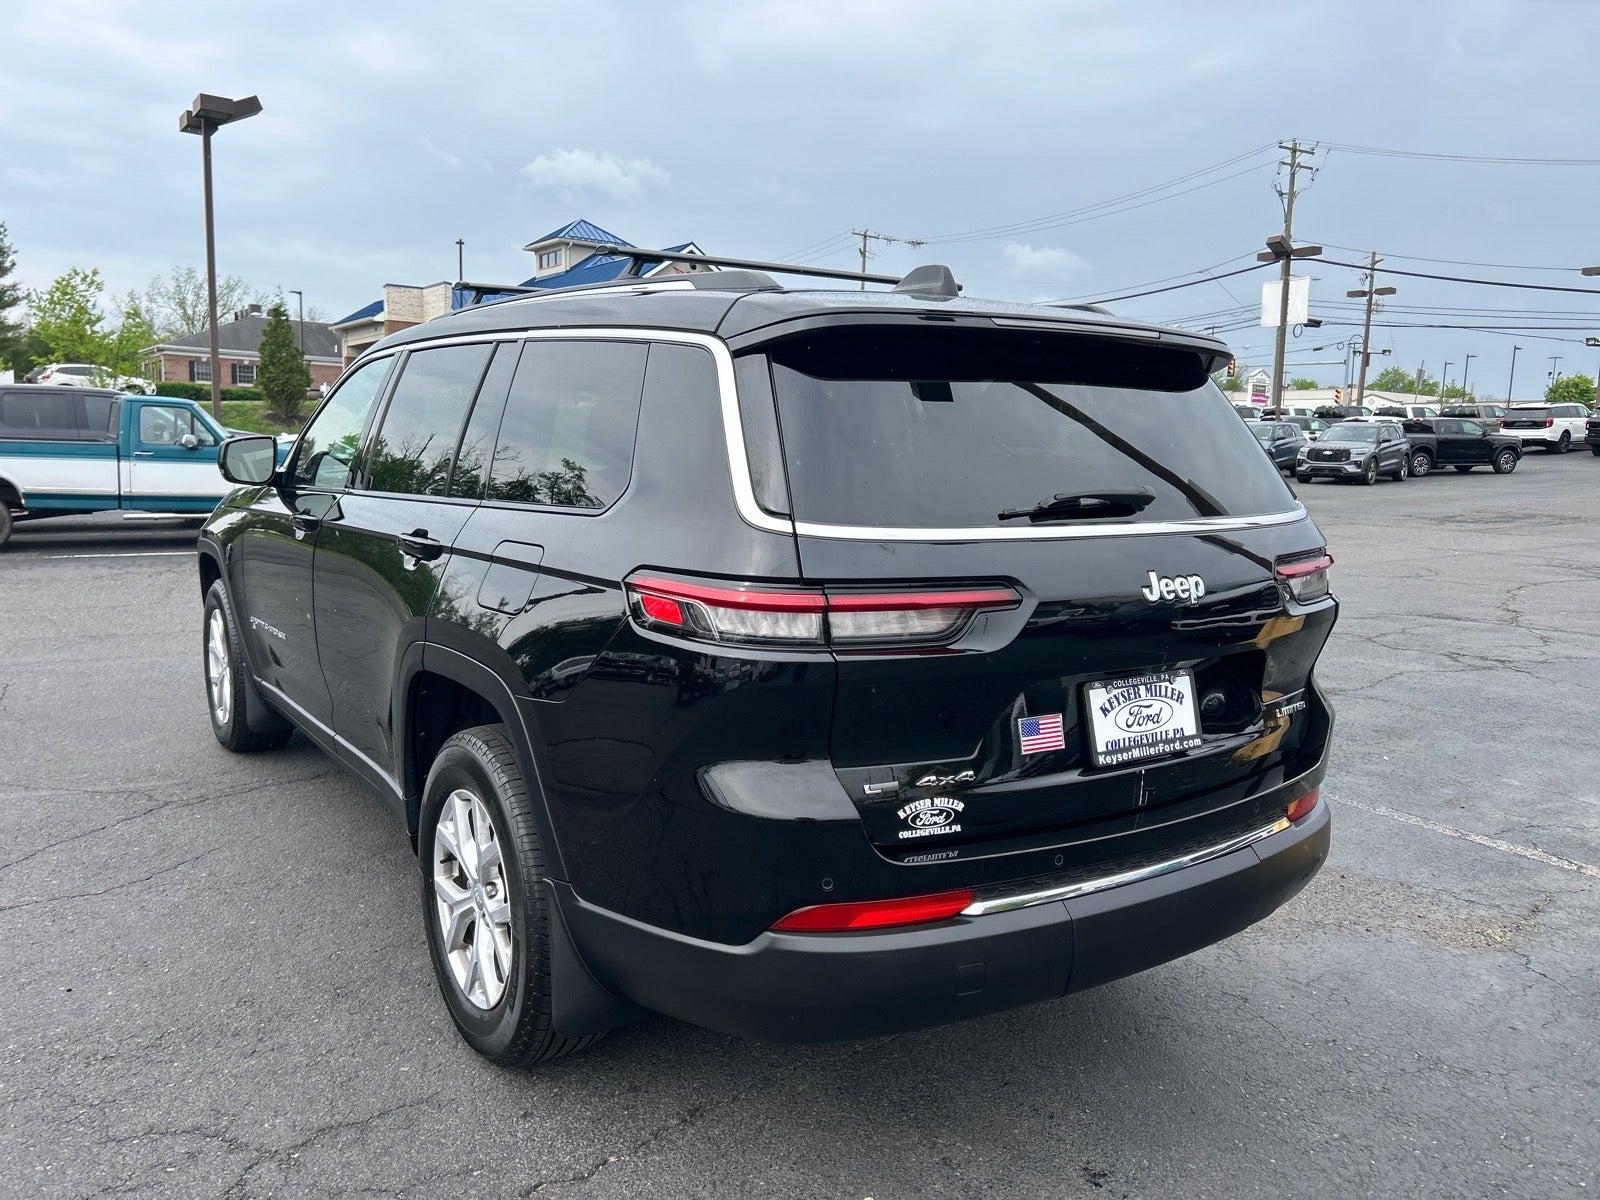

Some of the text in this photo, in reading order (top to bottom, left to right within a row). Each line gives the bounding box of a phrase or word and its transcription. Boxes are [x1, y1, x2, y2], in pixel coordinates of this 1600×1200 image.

[1141, 570, 1205, 607] Jeep
[1113, 675, 1160, 688] COLLEGEVILLE,
[1160, 673, 1170, 681] PA
[1099, 684, 1185, 718] KEYSER MILLER
[1125, 703, 1163, 729] Ford
[1098, 738, 1202, 765] KeyserMillerFord.com
[897, 797, 965, 820] KEYSER MILLER
[916, 809, 947, 826] Ford
